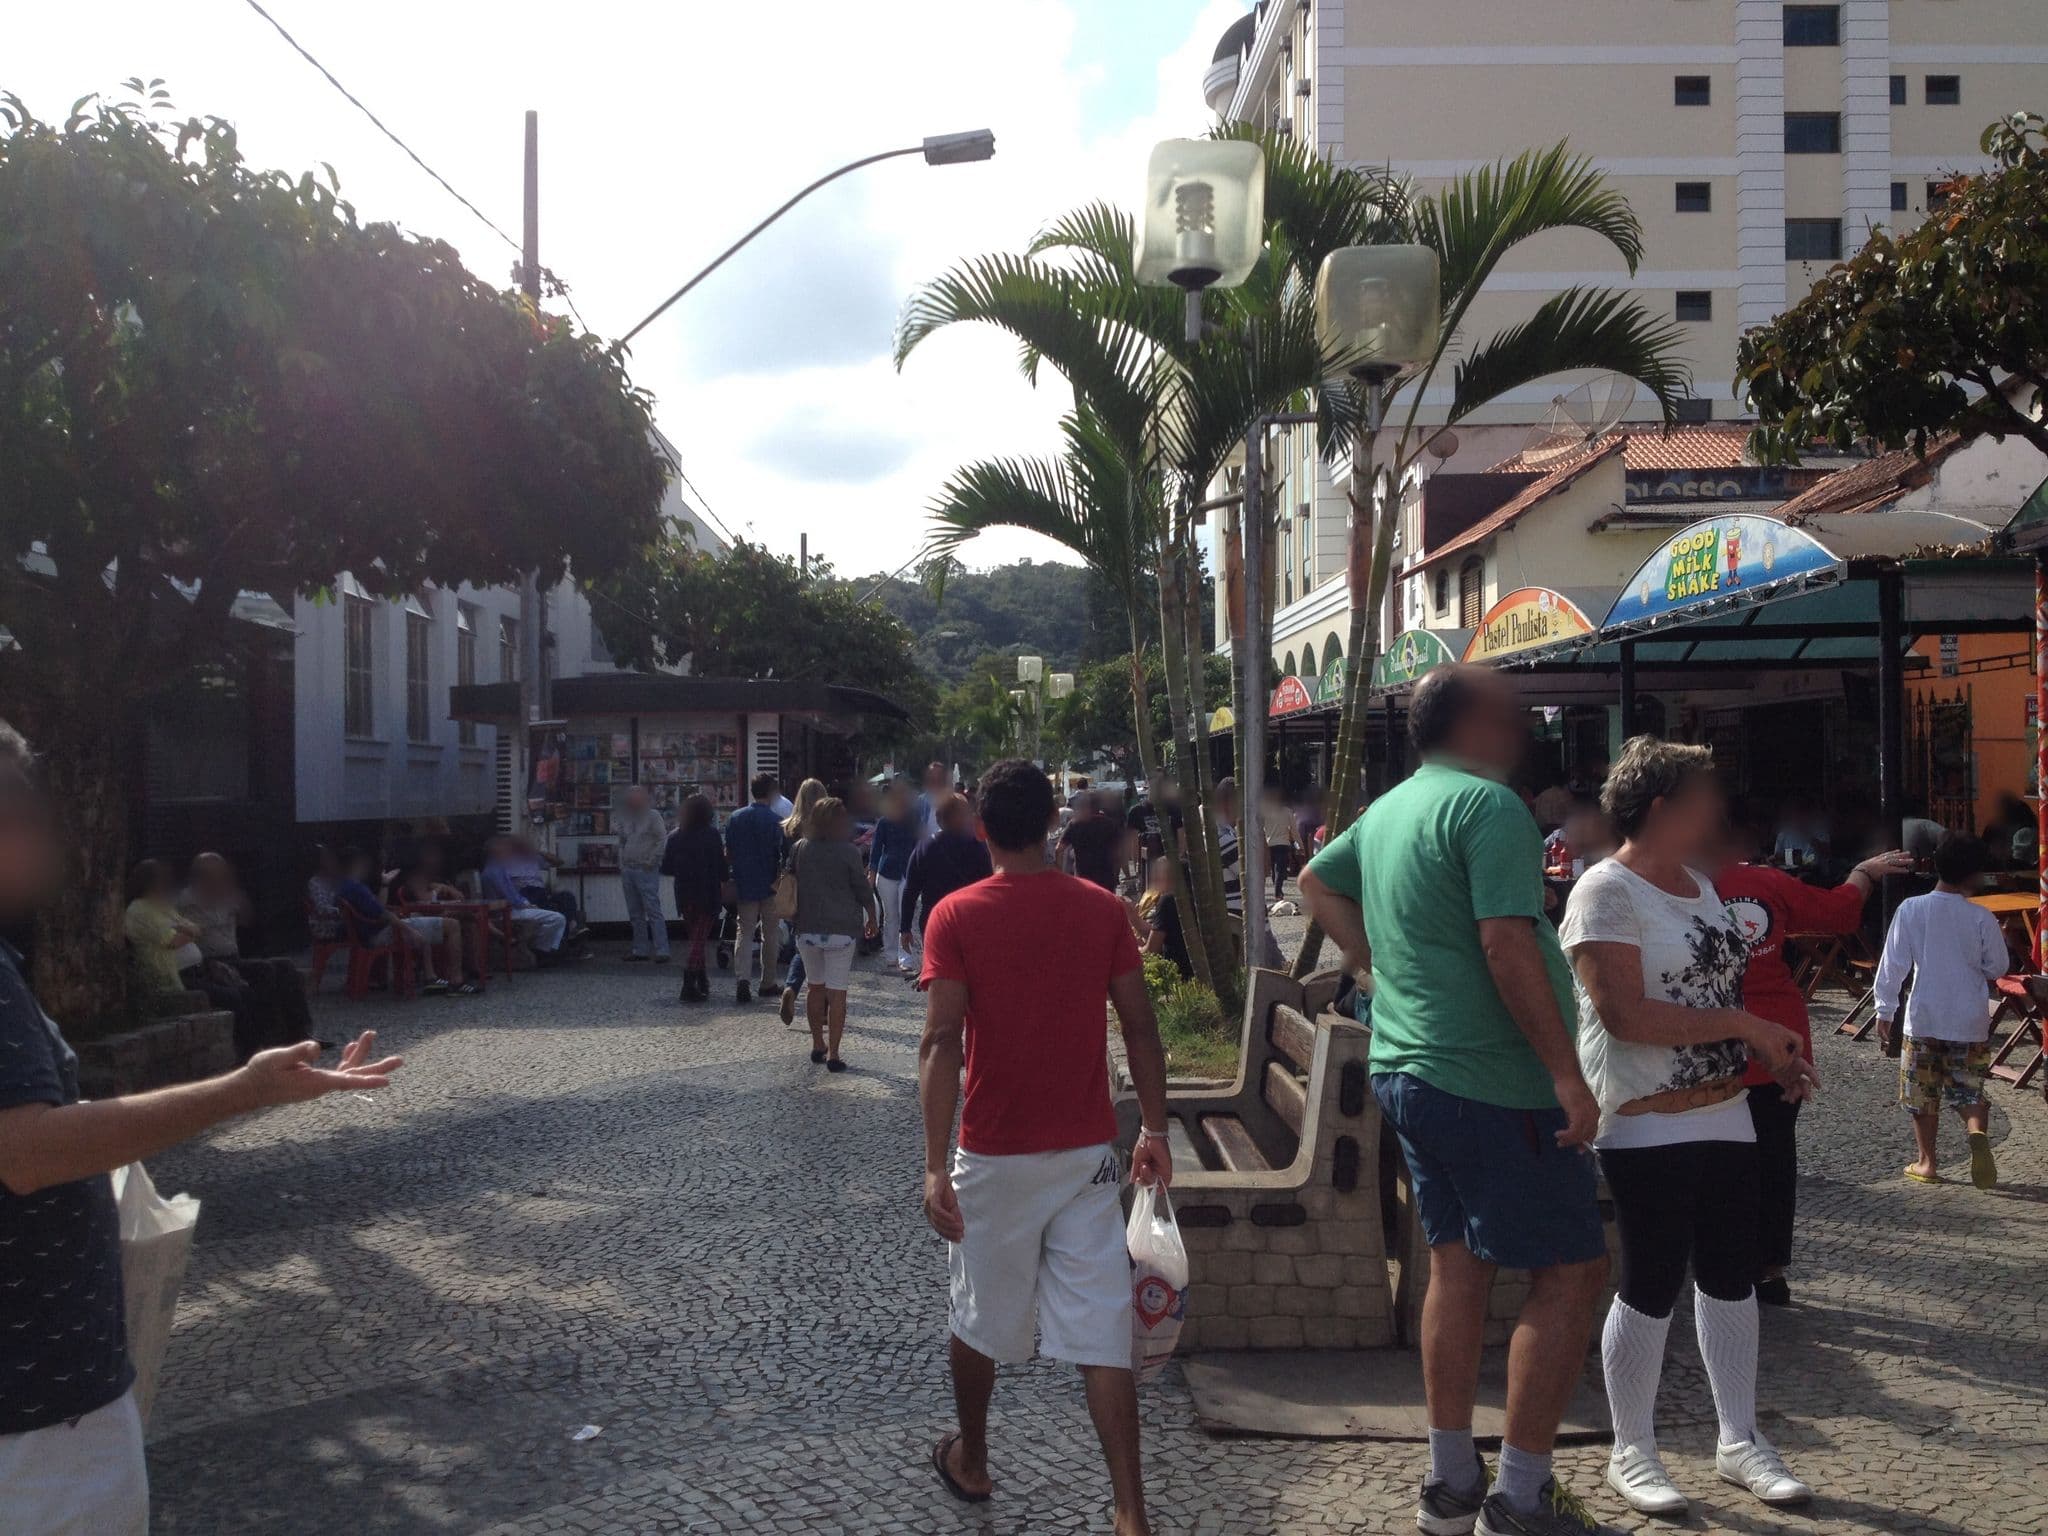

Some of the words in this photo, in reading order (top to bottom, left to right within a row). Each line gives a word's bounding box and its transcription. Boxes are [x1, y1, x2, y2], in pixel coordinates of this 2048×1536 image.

[1671, 531, 1713, 557] GOOD
[1668, 573, 1720, 601] SHAKE
[1484, 622, 1508, 652] Pastel
[1511, 608, 1547, 645] Paulista
[1724, 897, 1758, 906] NTINA
